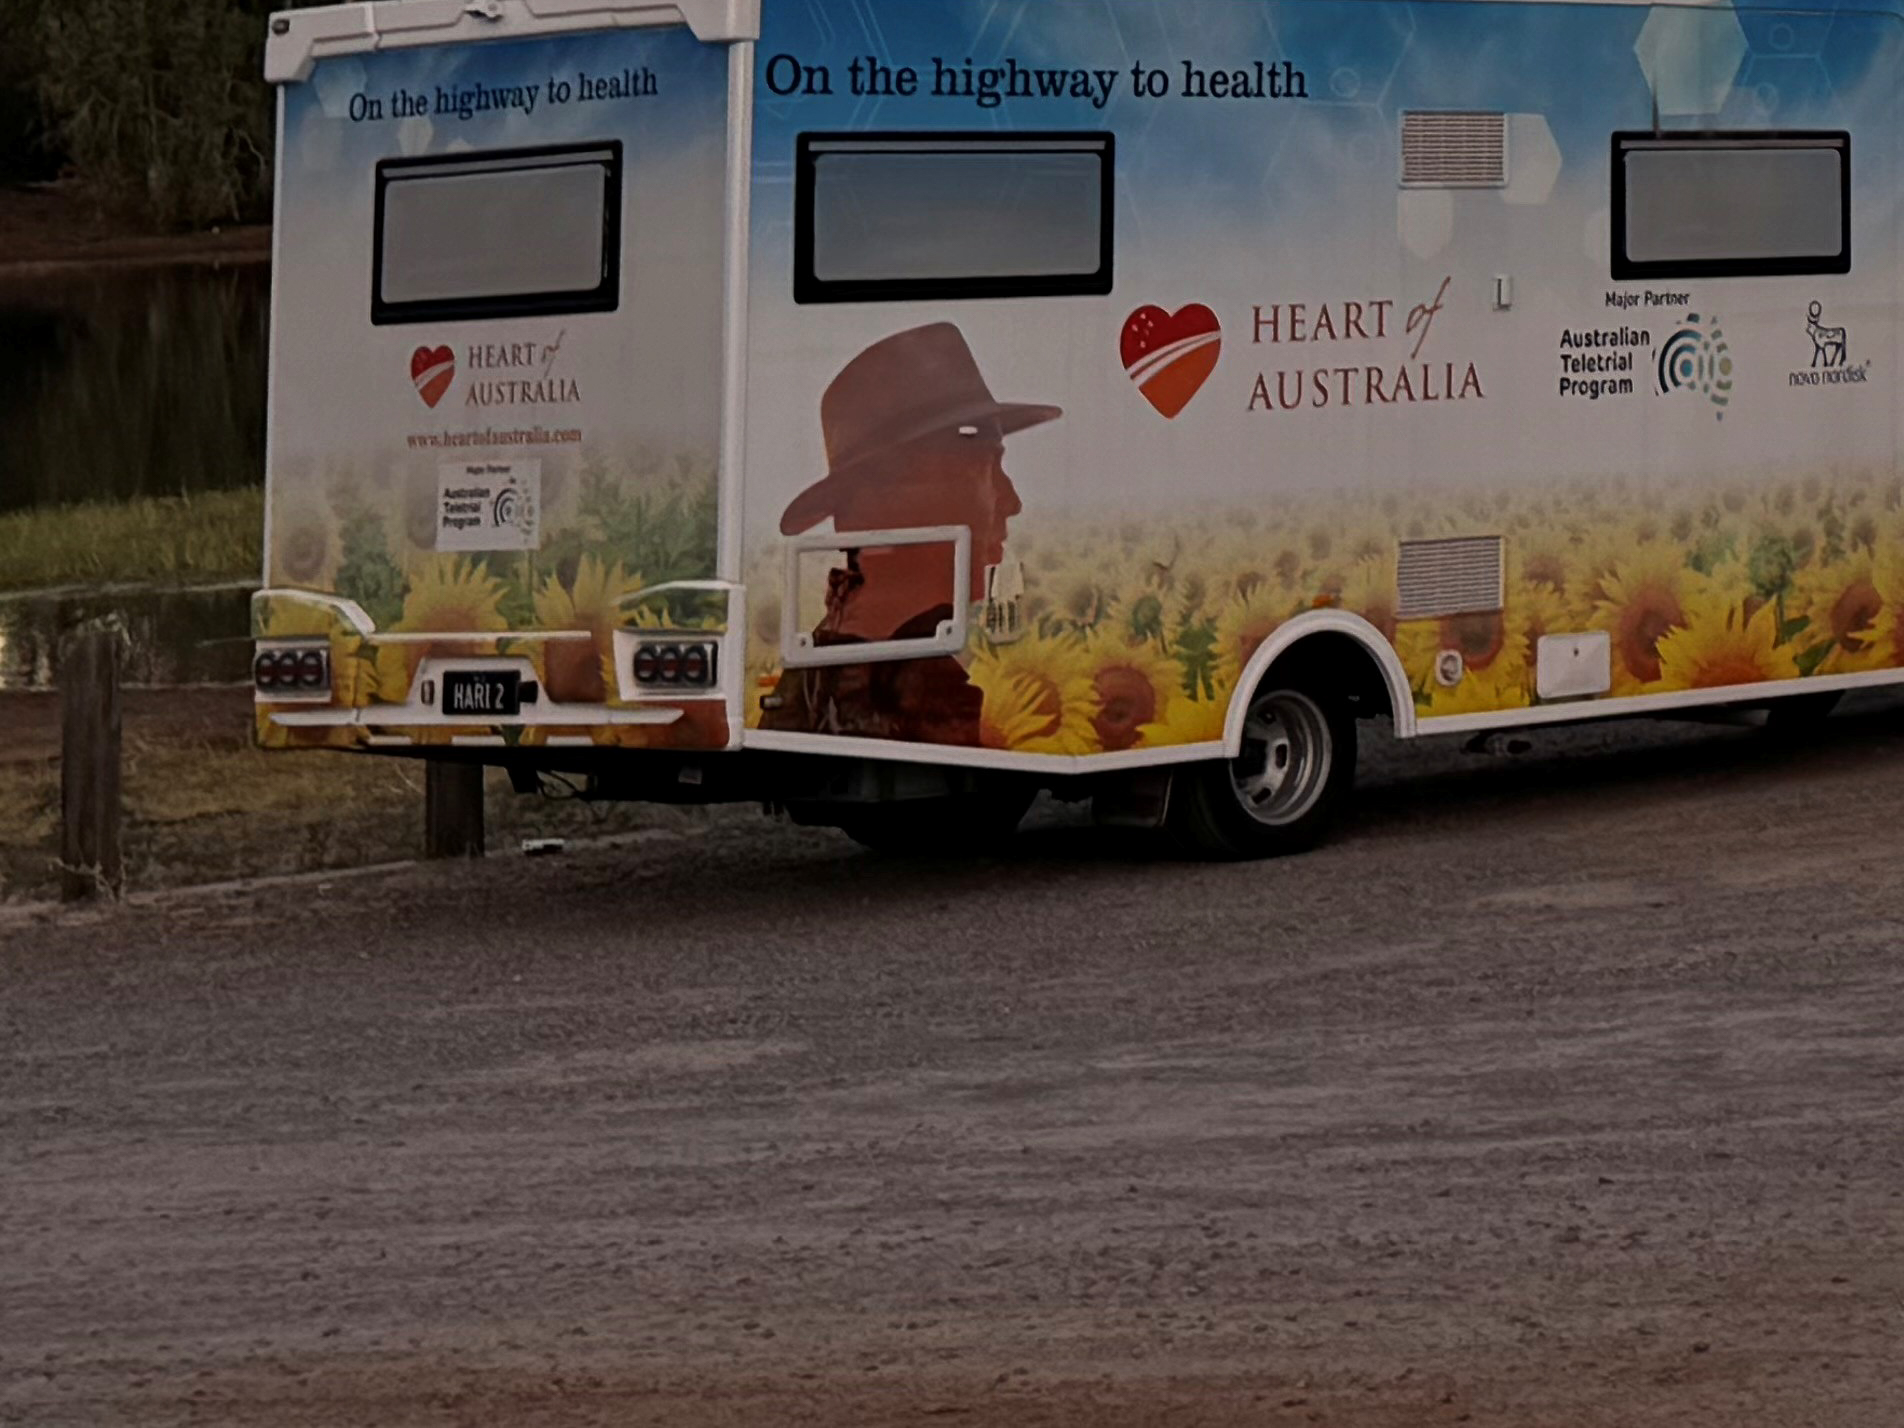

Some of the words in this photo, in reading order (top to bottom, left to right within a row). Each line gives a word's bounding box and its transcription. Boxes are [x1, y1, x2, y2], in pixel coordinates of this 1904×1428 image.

[350, 92, 383, 122] On
[391, 89, 427, 118] the
[434, 82, 540, 121] highway
[547, 76, 571, 104] to
[577, 66, 658, 102] health
[766, 54, 833, 95] On
[848, 56, 917, 96] the
[931, 57, 1118, 109] highway
[1131, 60, 1169, 98] to
[1181, 60, 1308, 98] health
[1605, 291, 1640, 310] Major
[1644, 290, 1690, 307] Partner
[1252, 299, 1393, 344] HEART
[1406, 275, 1451, 360] of
[1559, 326, 1650, 348] Australian
[469, 342, 536, 369] HEART
[1560, 351, 1633, 373] Teletrial
[465, 378, 581, 406] AUSTRALIA
[1247, 361, 1485, 412] AUSTRALIA
[1559, 377, 1633, 400] Program
[407, 425, 582, 448] www.heartofaustralia.com
[495, 682, 504, 710] 2
